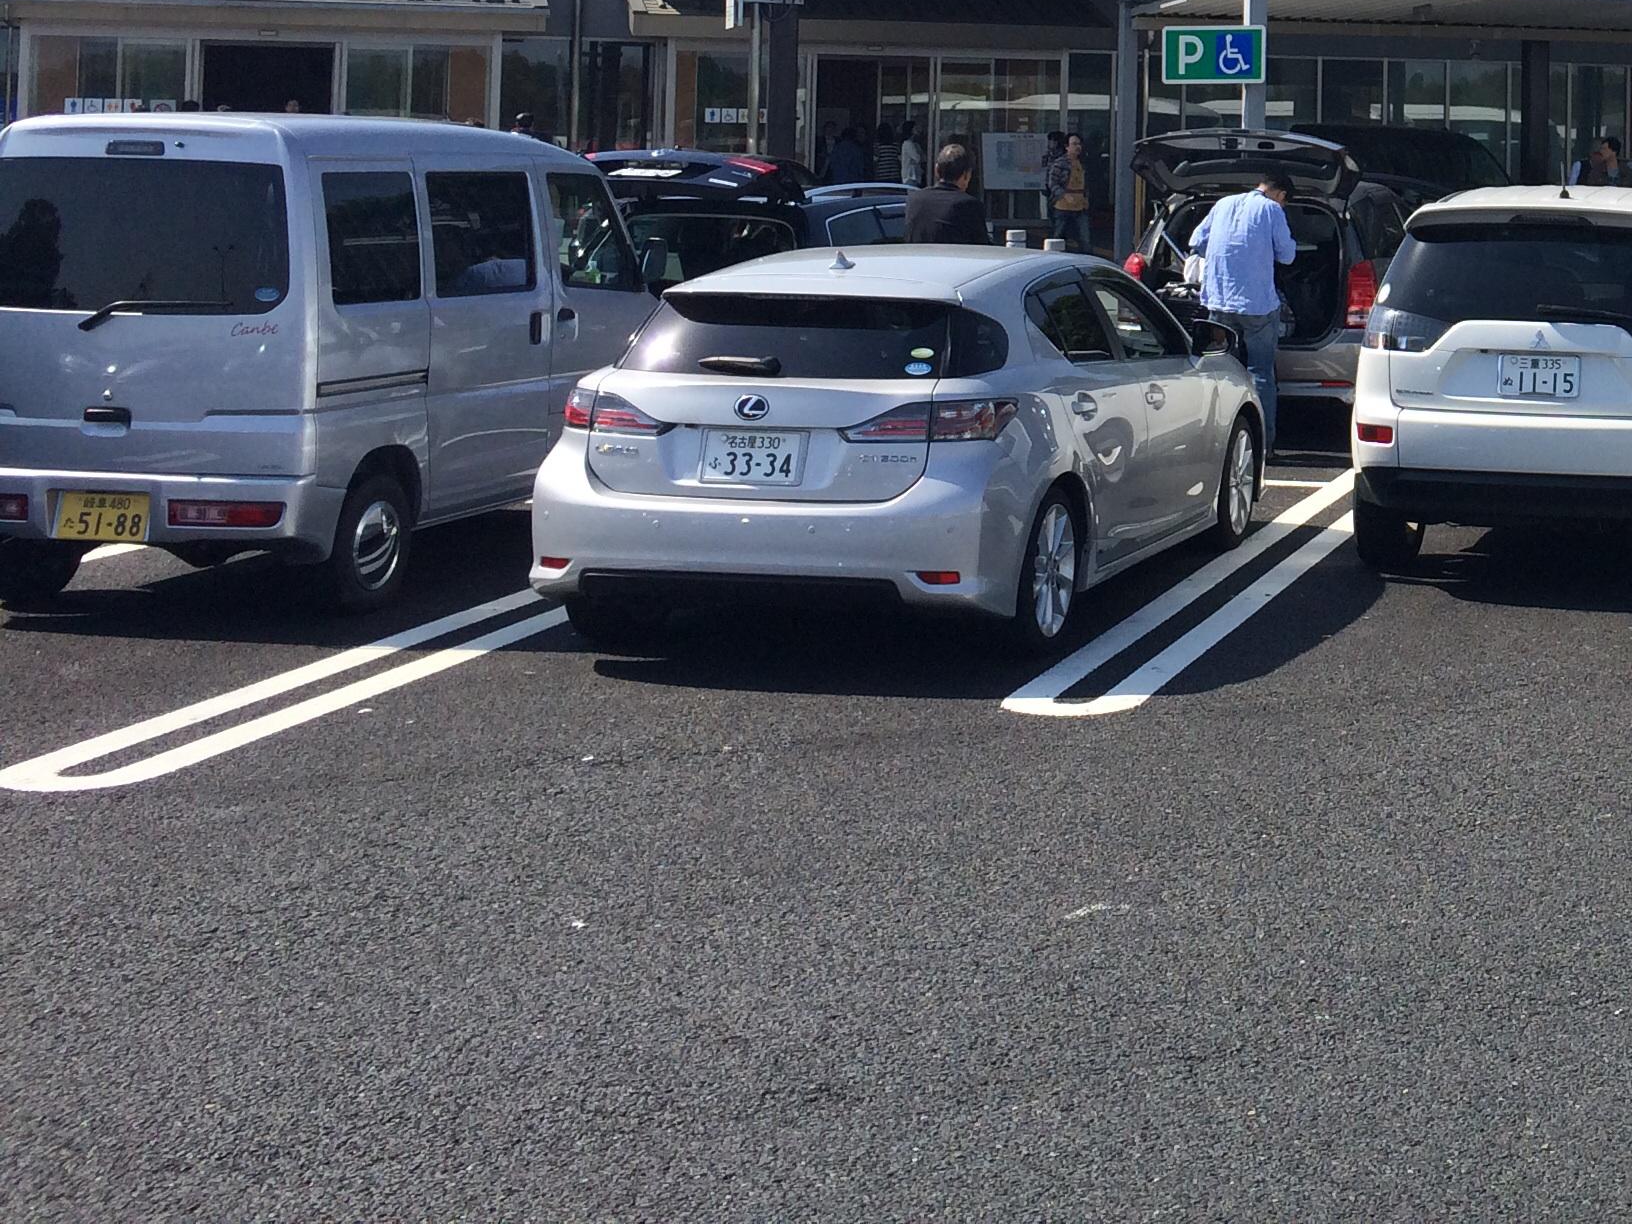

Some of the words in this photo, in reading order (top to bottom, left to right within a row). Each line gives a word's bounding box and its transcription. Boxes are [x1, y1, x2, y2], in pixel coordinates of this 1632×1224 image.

[1179, 35, 1204, 75] P
[1518, 371, 1574, 394] 11-15
[723, 451, 793, 478] 33-34
[76, 511, 143, 537] 51-88
